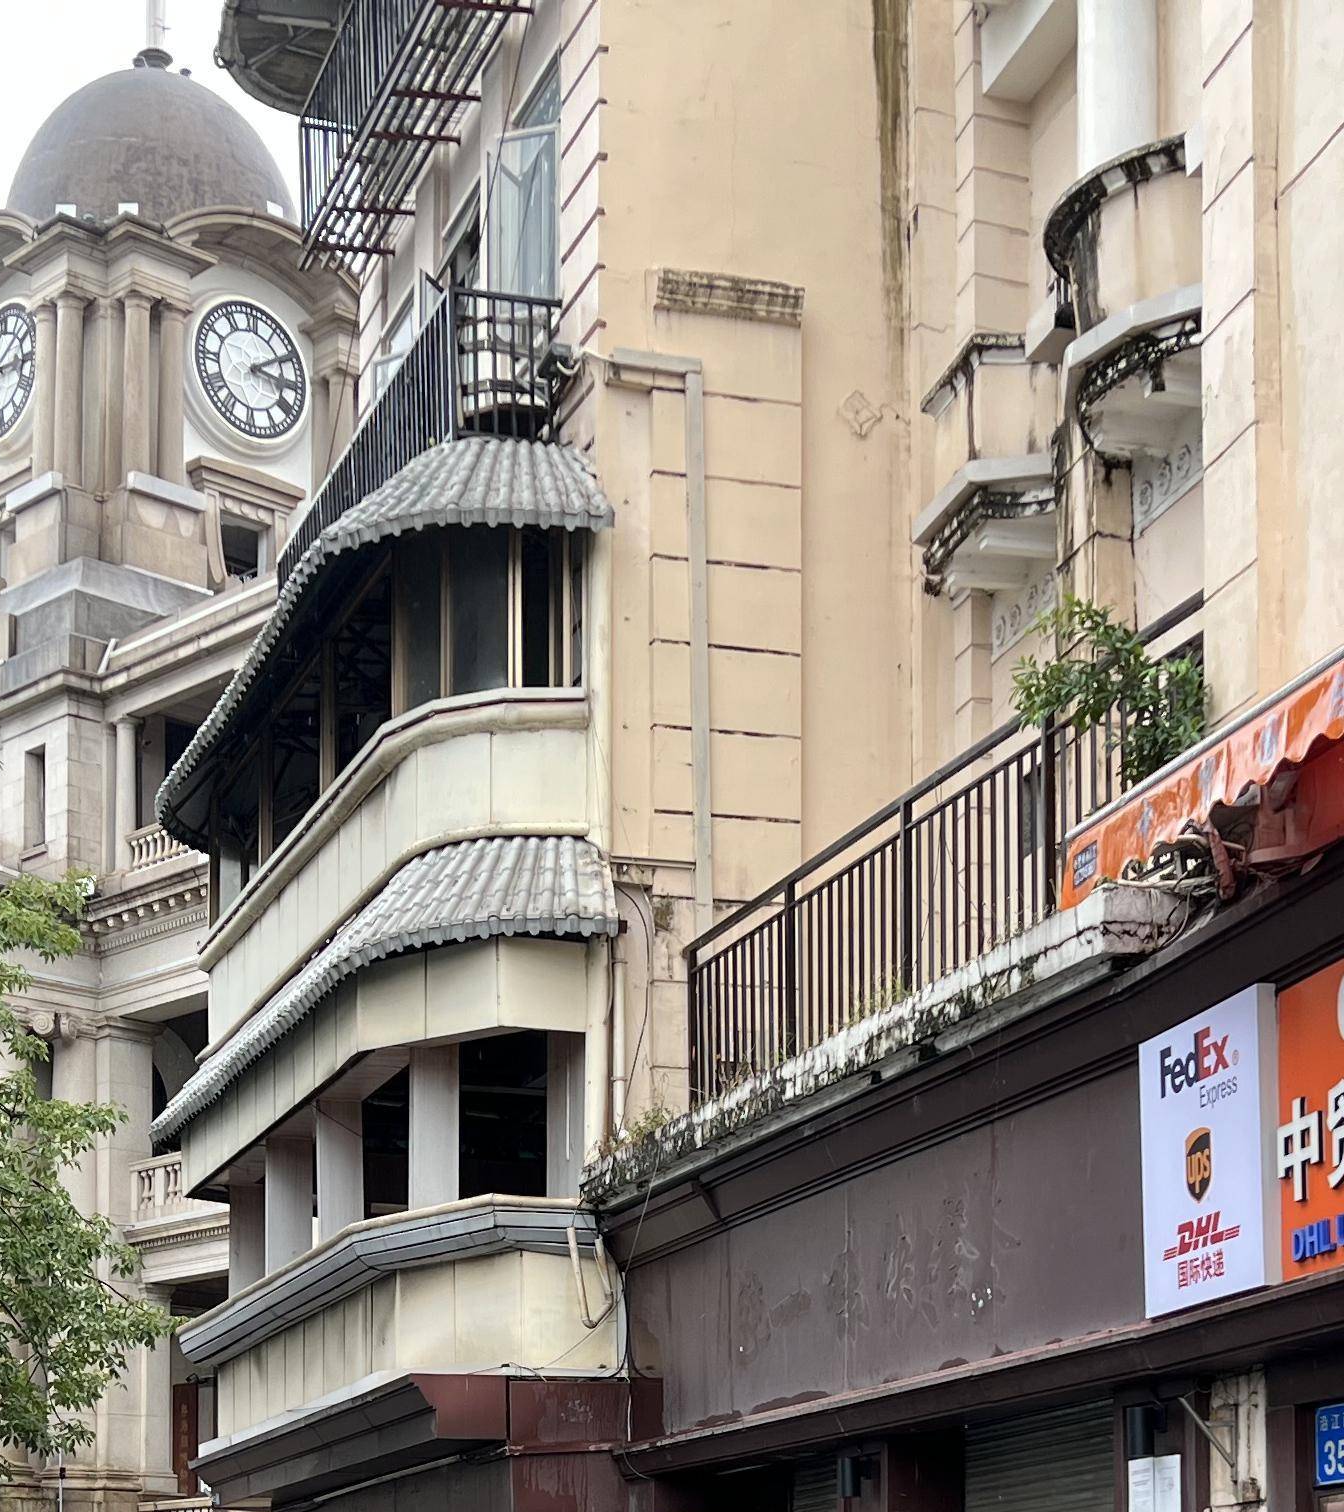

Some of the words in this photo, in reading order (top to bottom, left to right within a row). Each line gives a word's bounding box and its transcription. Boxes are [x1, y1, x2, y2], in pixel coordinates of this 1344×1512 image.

[1159, 1026, 1229, 1099] FedEx
[1199, 1075, 1238, 1109] Express
[1176, 1211, 1226, 1255] DHL
[1177, 1249, 1225, 1289] 国际快递
